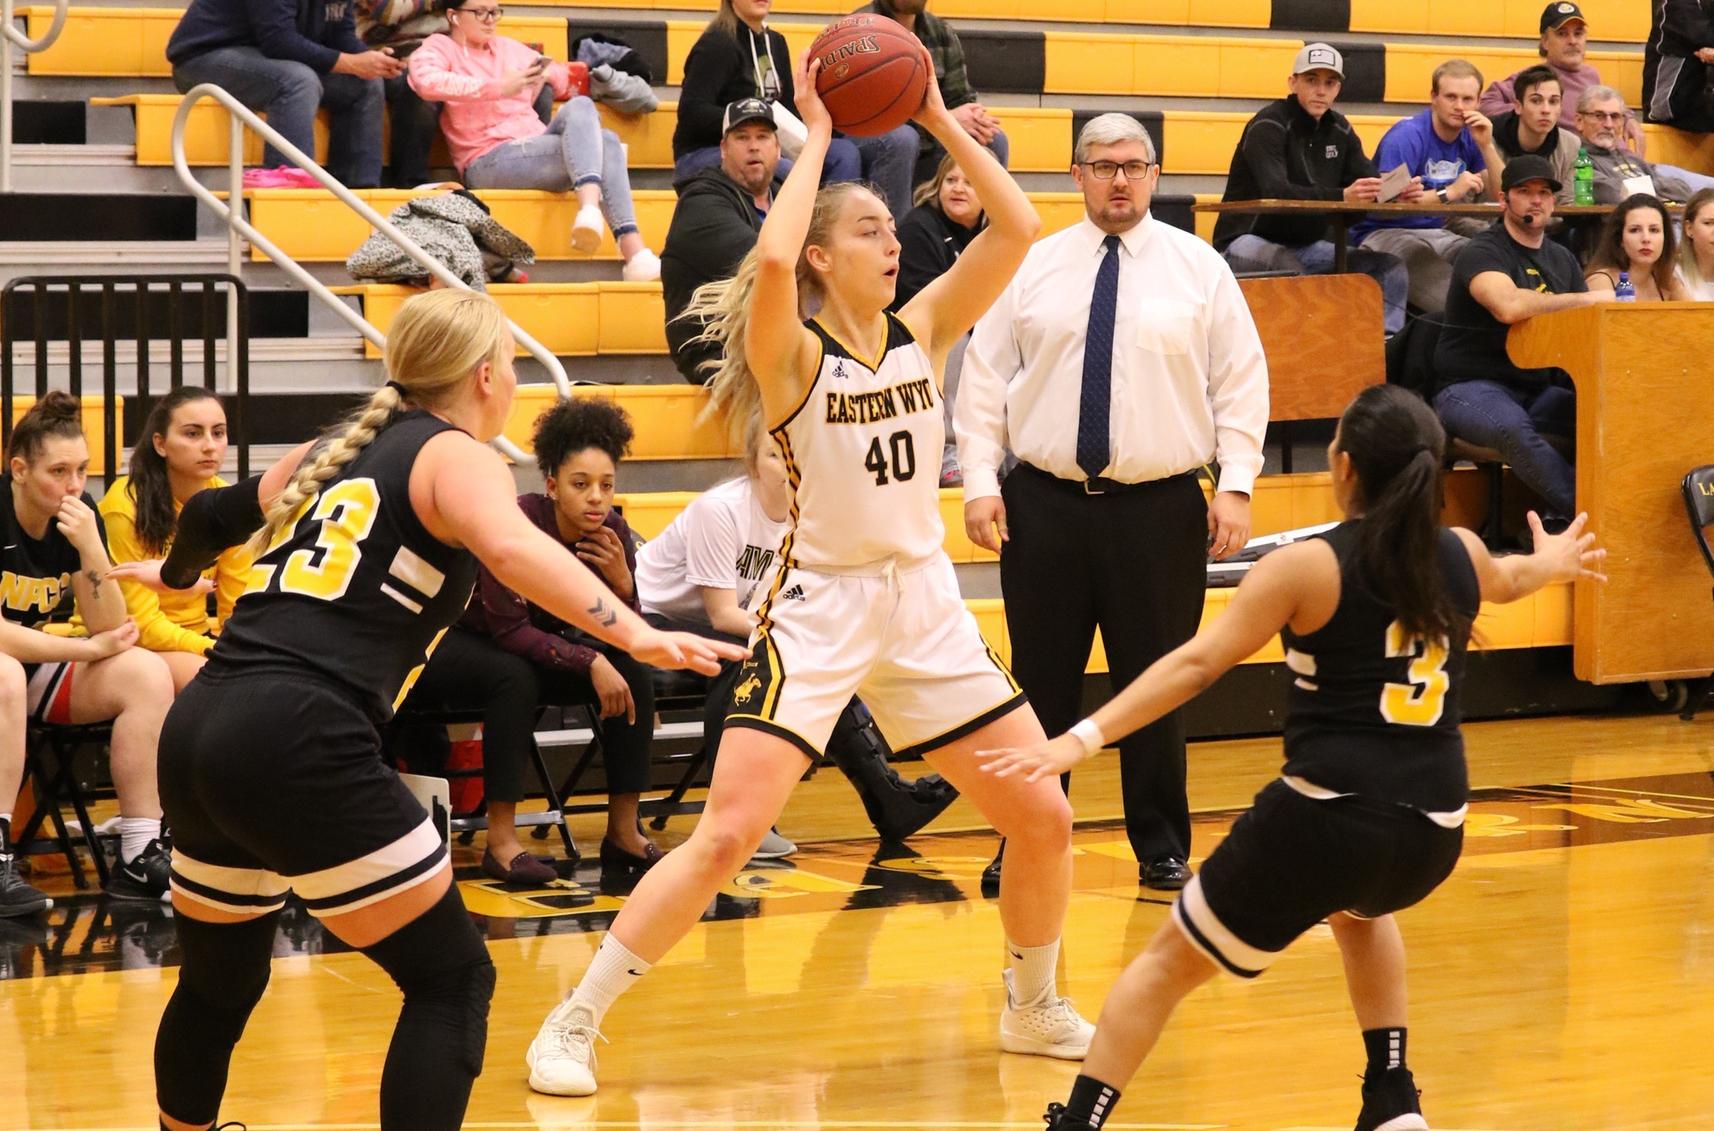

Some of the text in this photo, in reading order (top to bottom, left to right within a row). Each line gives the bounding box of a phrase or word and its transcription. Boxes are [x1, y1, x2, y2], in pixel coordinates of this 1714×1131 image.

[825, 387, 898, 424] EASTERN
[864, 429, 916, 487] 40
[242, 477, 381, 601] 23
[1379, 618, 1450, 727] 3
